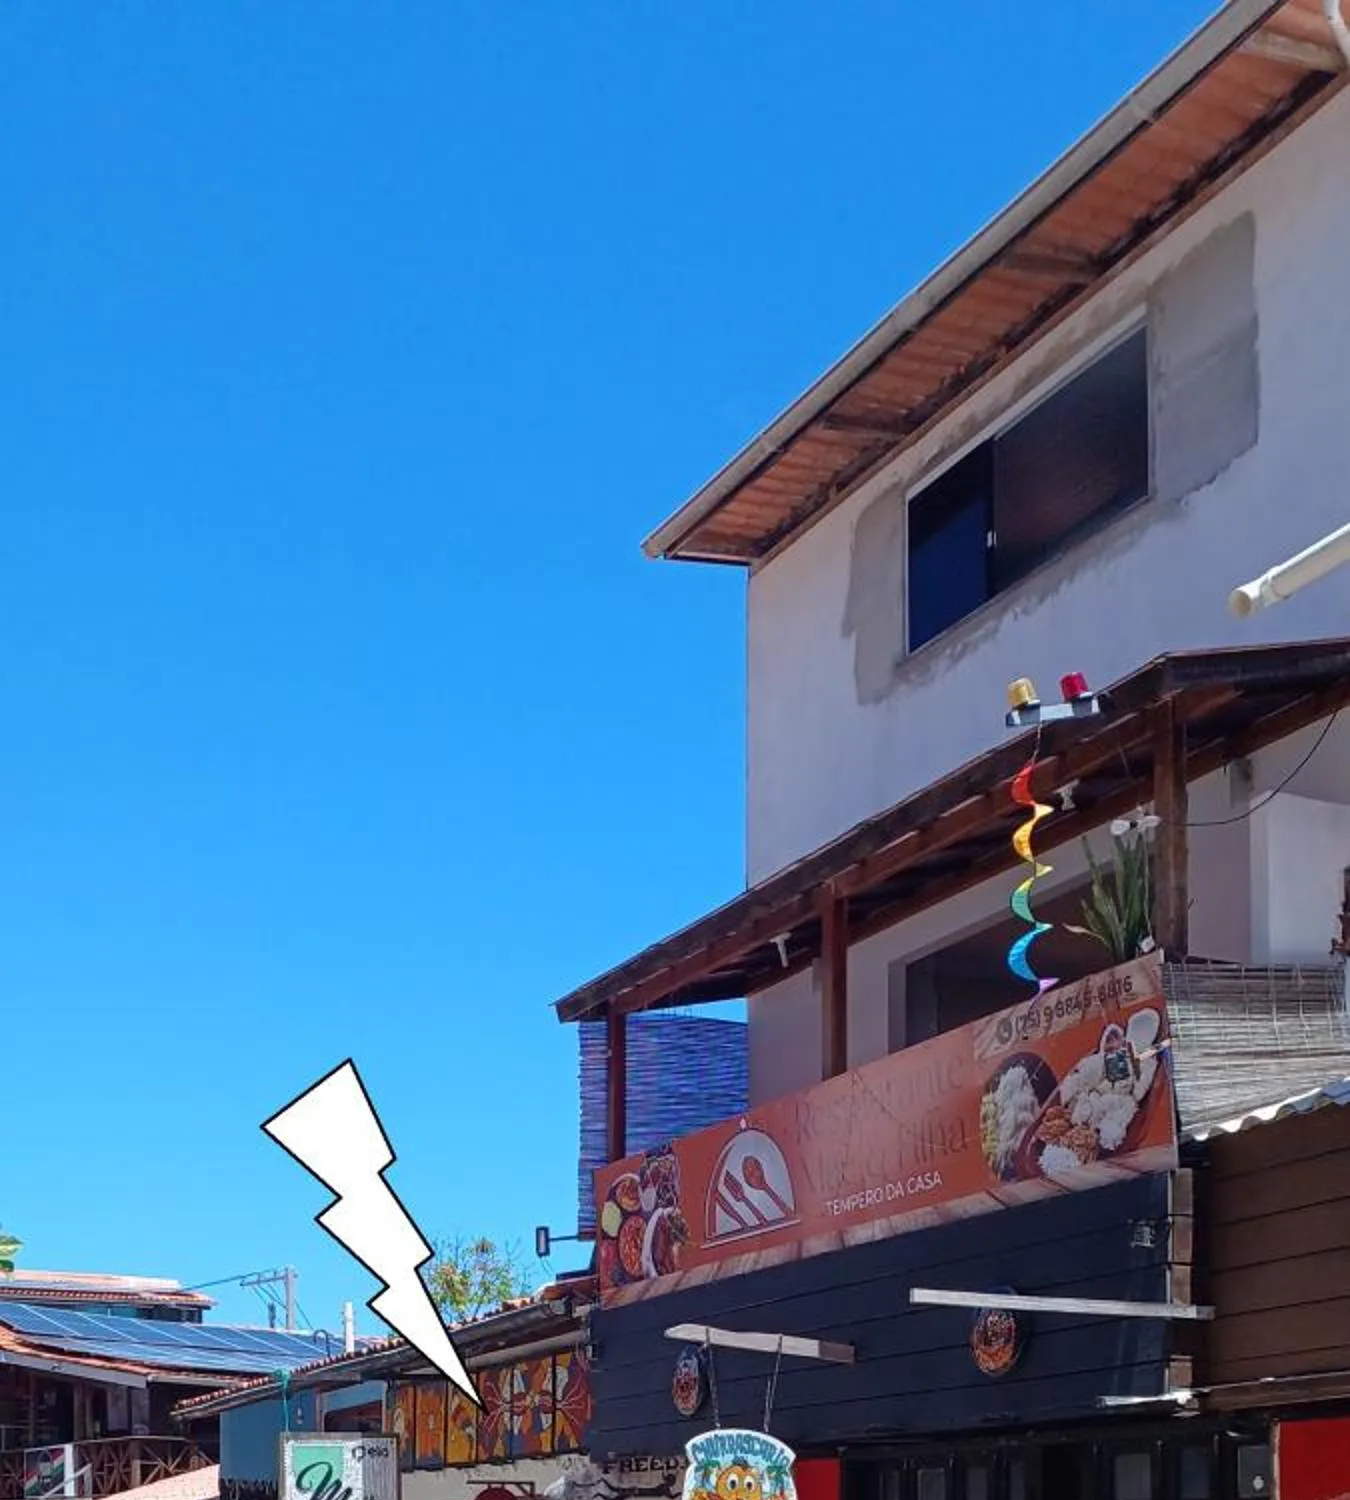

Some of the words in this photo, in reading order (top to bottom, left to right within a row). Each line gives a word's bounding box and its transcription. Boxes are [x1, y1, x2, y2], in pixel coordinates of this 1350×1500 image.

[826, 1186, 884, 1216] TEMPERO
[886, 1182, 906, 1202] DA
[907, 1170, 943, 1195] CASA
